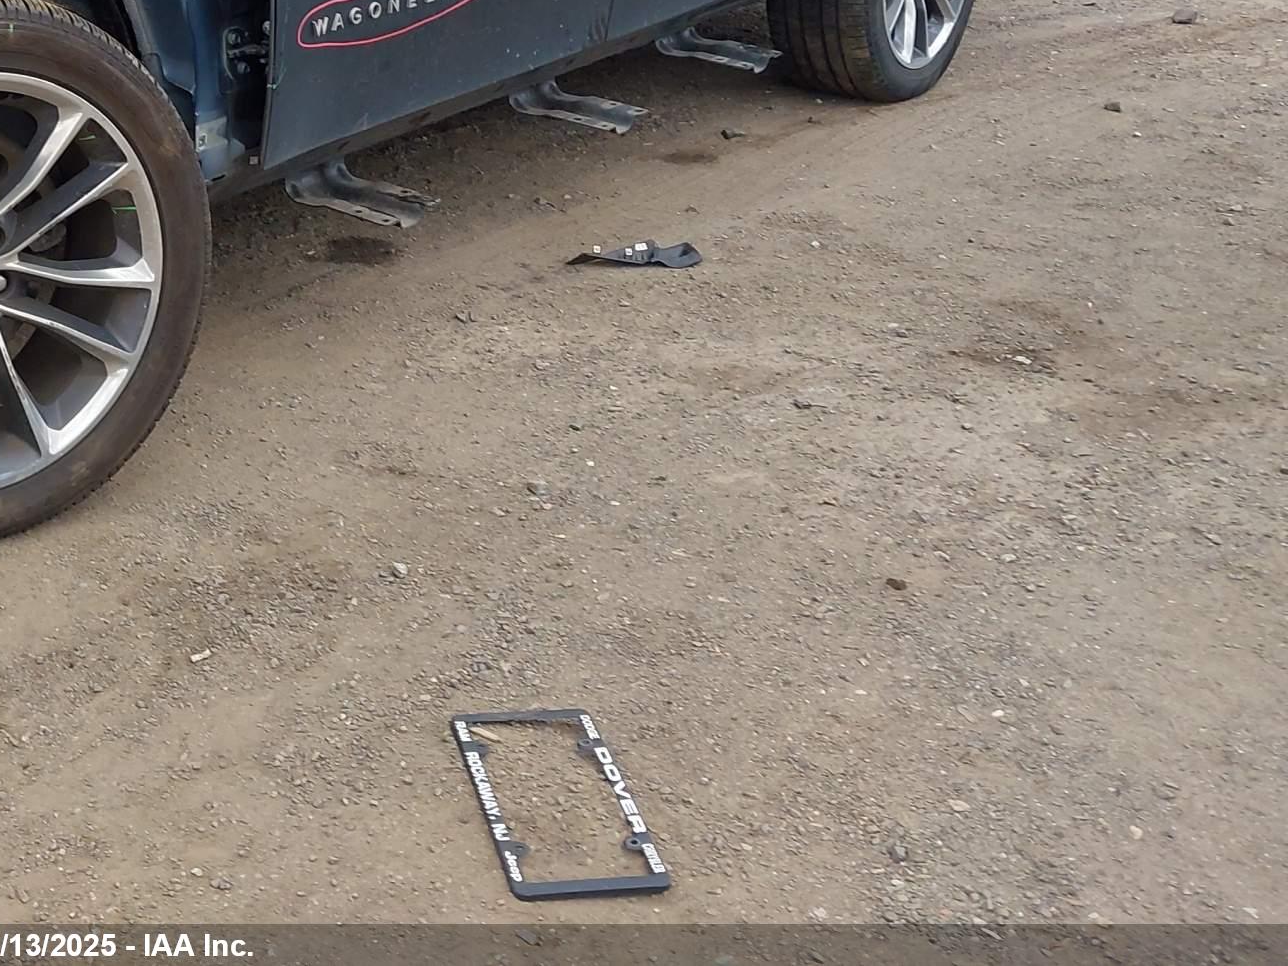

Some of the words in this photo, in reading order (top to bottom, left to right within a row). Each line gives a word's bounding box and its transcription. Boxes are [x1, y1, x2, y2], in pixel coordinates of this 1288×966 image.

[593, 746, 648, 834] DOVER
[490, 823, 511, 842] NJ
[504, 850, 524, 883] Jeep
